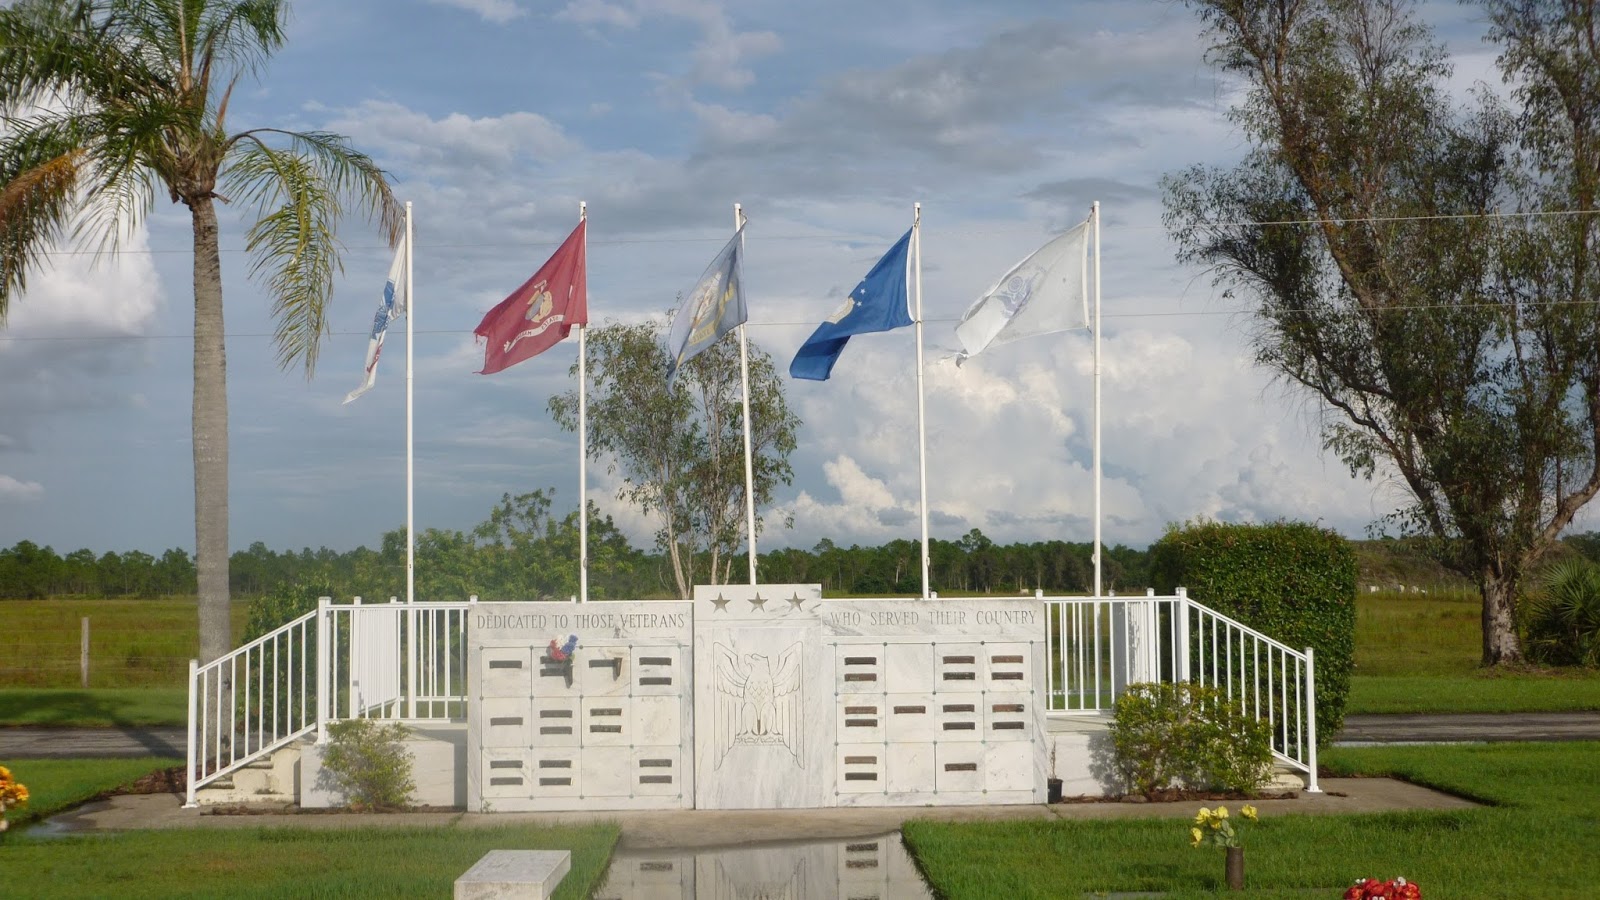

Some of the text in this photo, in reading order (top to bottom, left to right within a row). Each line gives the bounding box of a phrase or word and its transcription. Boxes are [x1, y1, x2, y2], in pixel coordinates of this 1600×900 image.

[477, 613, 685, 629] DEDICATED TO THOSE VETERANS
[830, 610, 1037, 626] WHO SERVED THEIR COUNTRY
